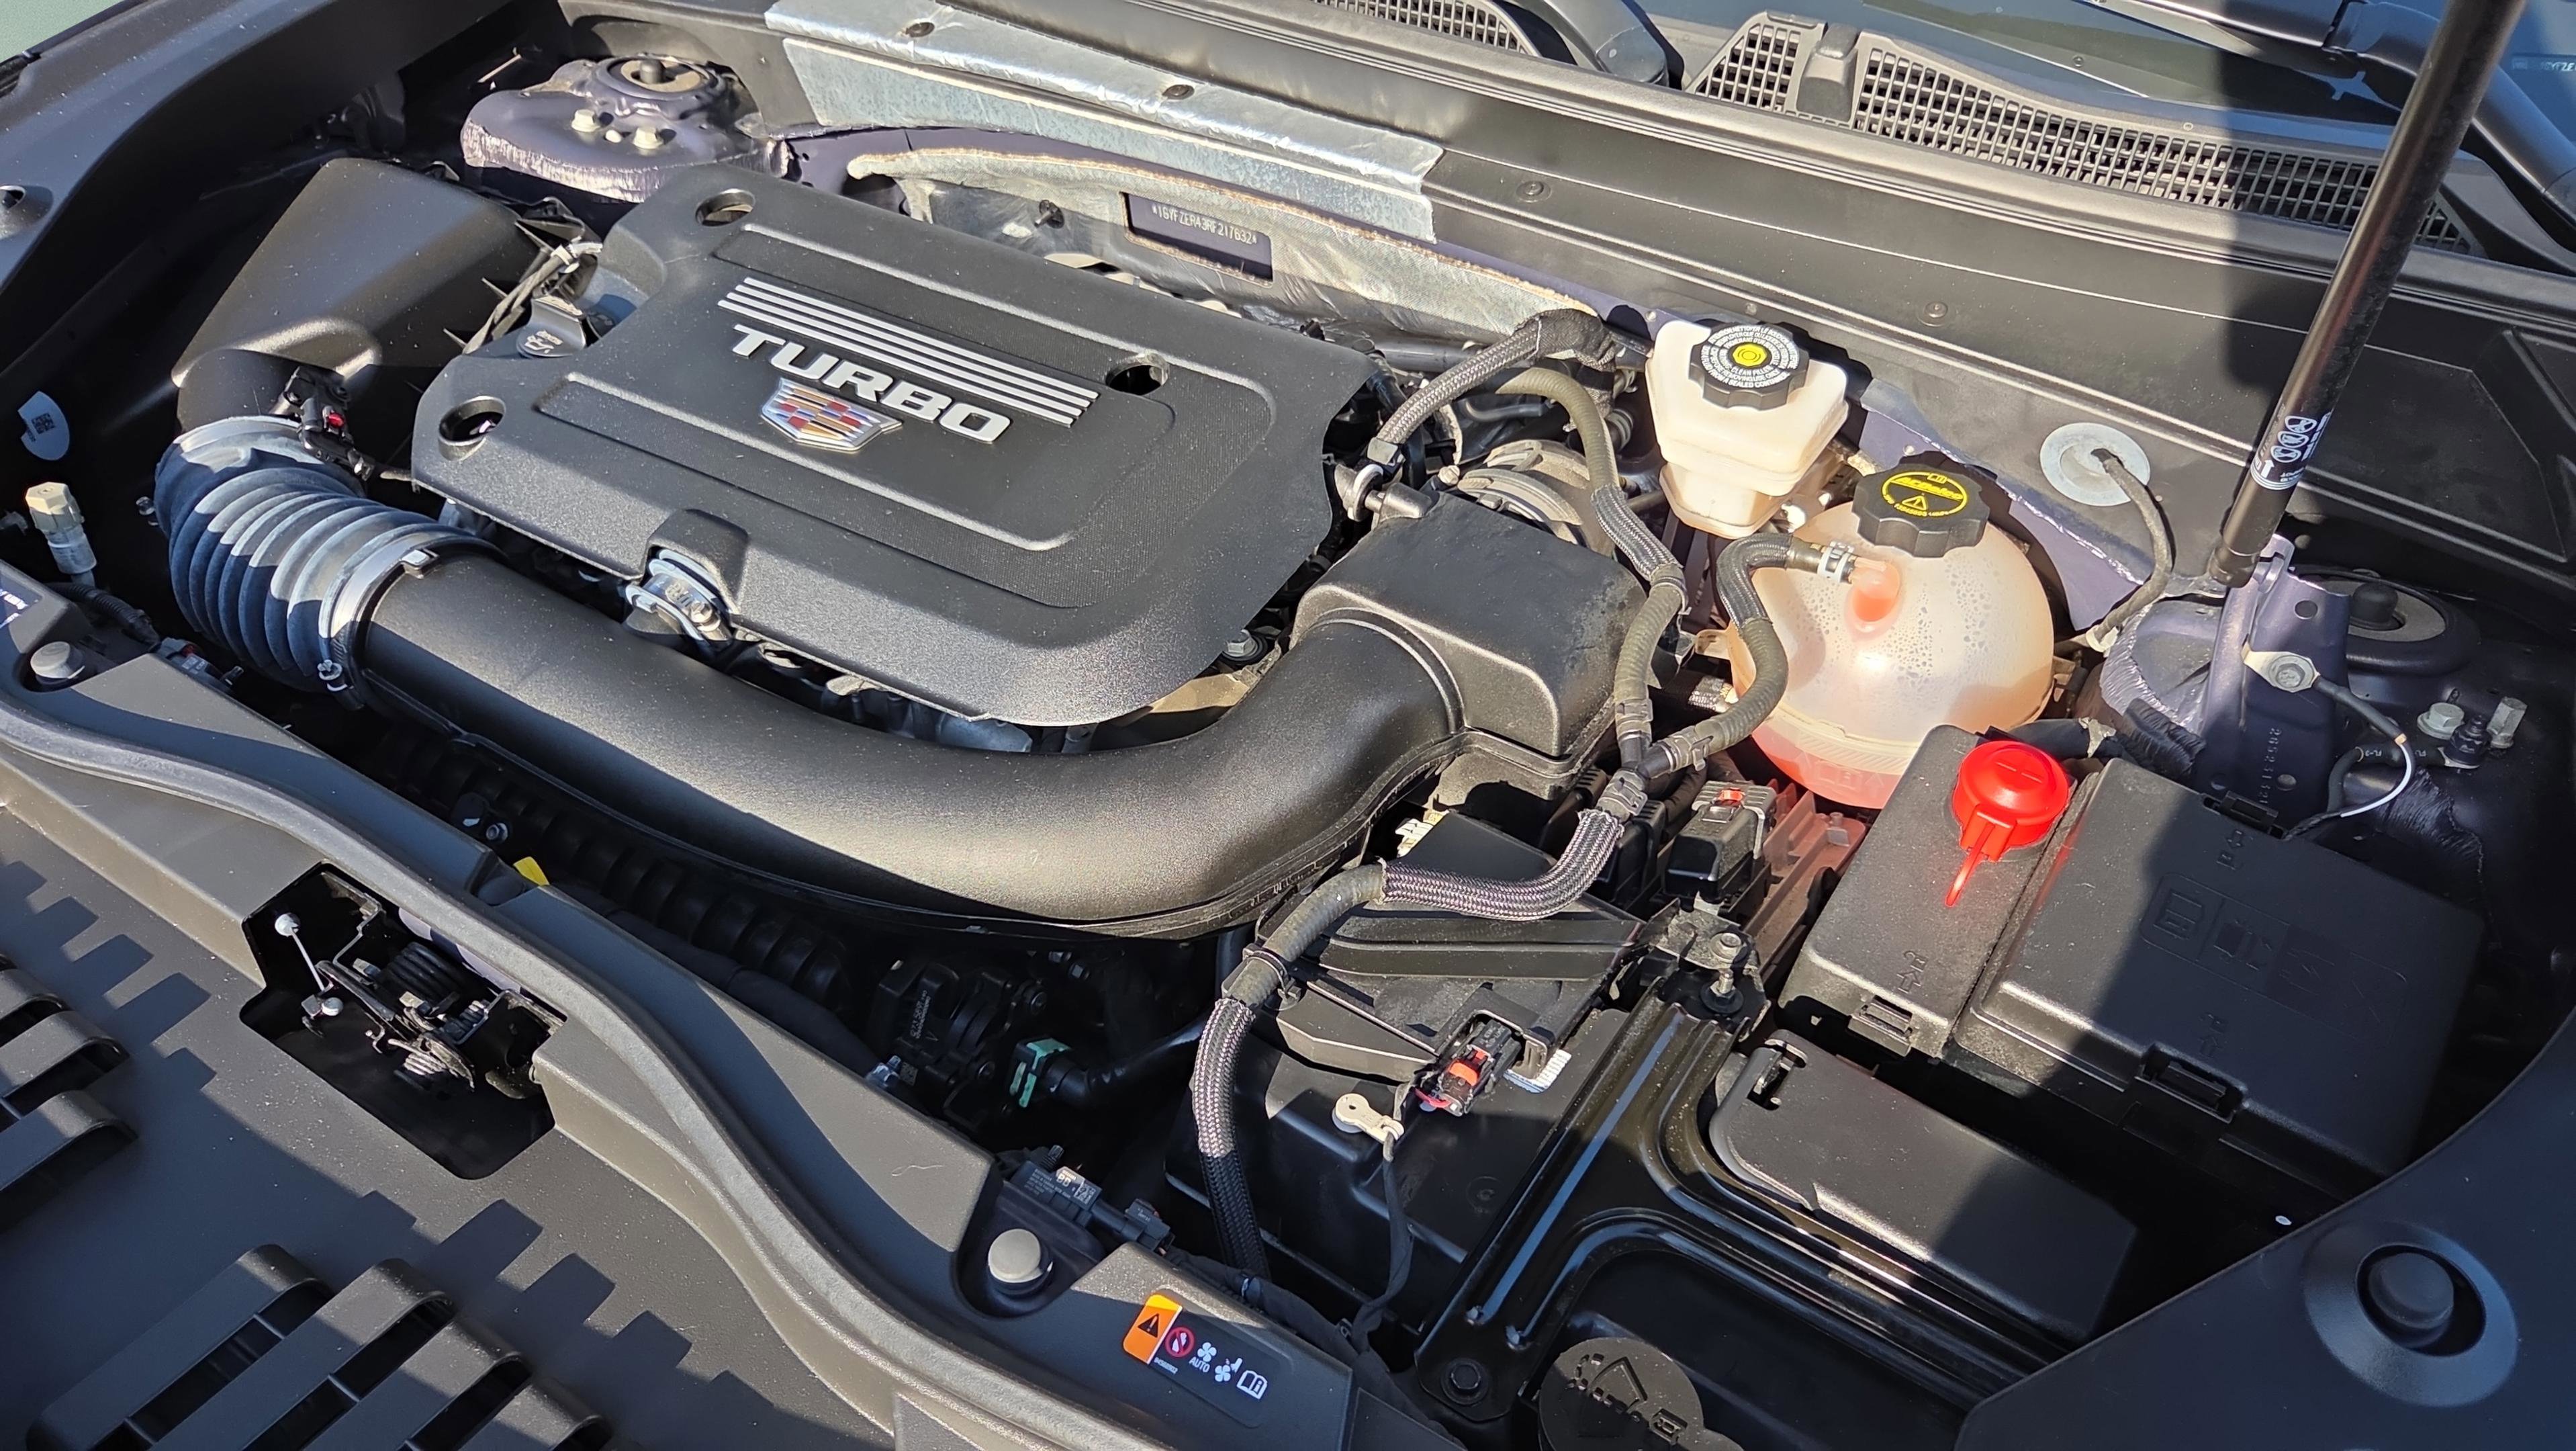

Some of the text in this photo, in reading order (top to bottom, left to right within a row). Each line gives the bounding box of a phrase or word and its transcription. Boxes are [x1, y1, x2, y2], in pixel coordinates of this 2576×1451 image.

[1731, 366, 1752, 376] CLEAN
[733, 324, 1011, 443] TURBO
[1189, 1356, 1211, 1373] AUTO
